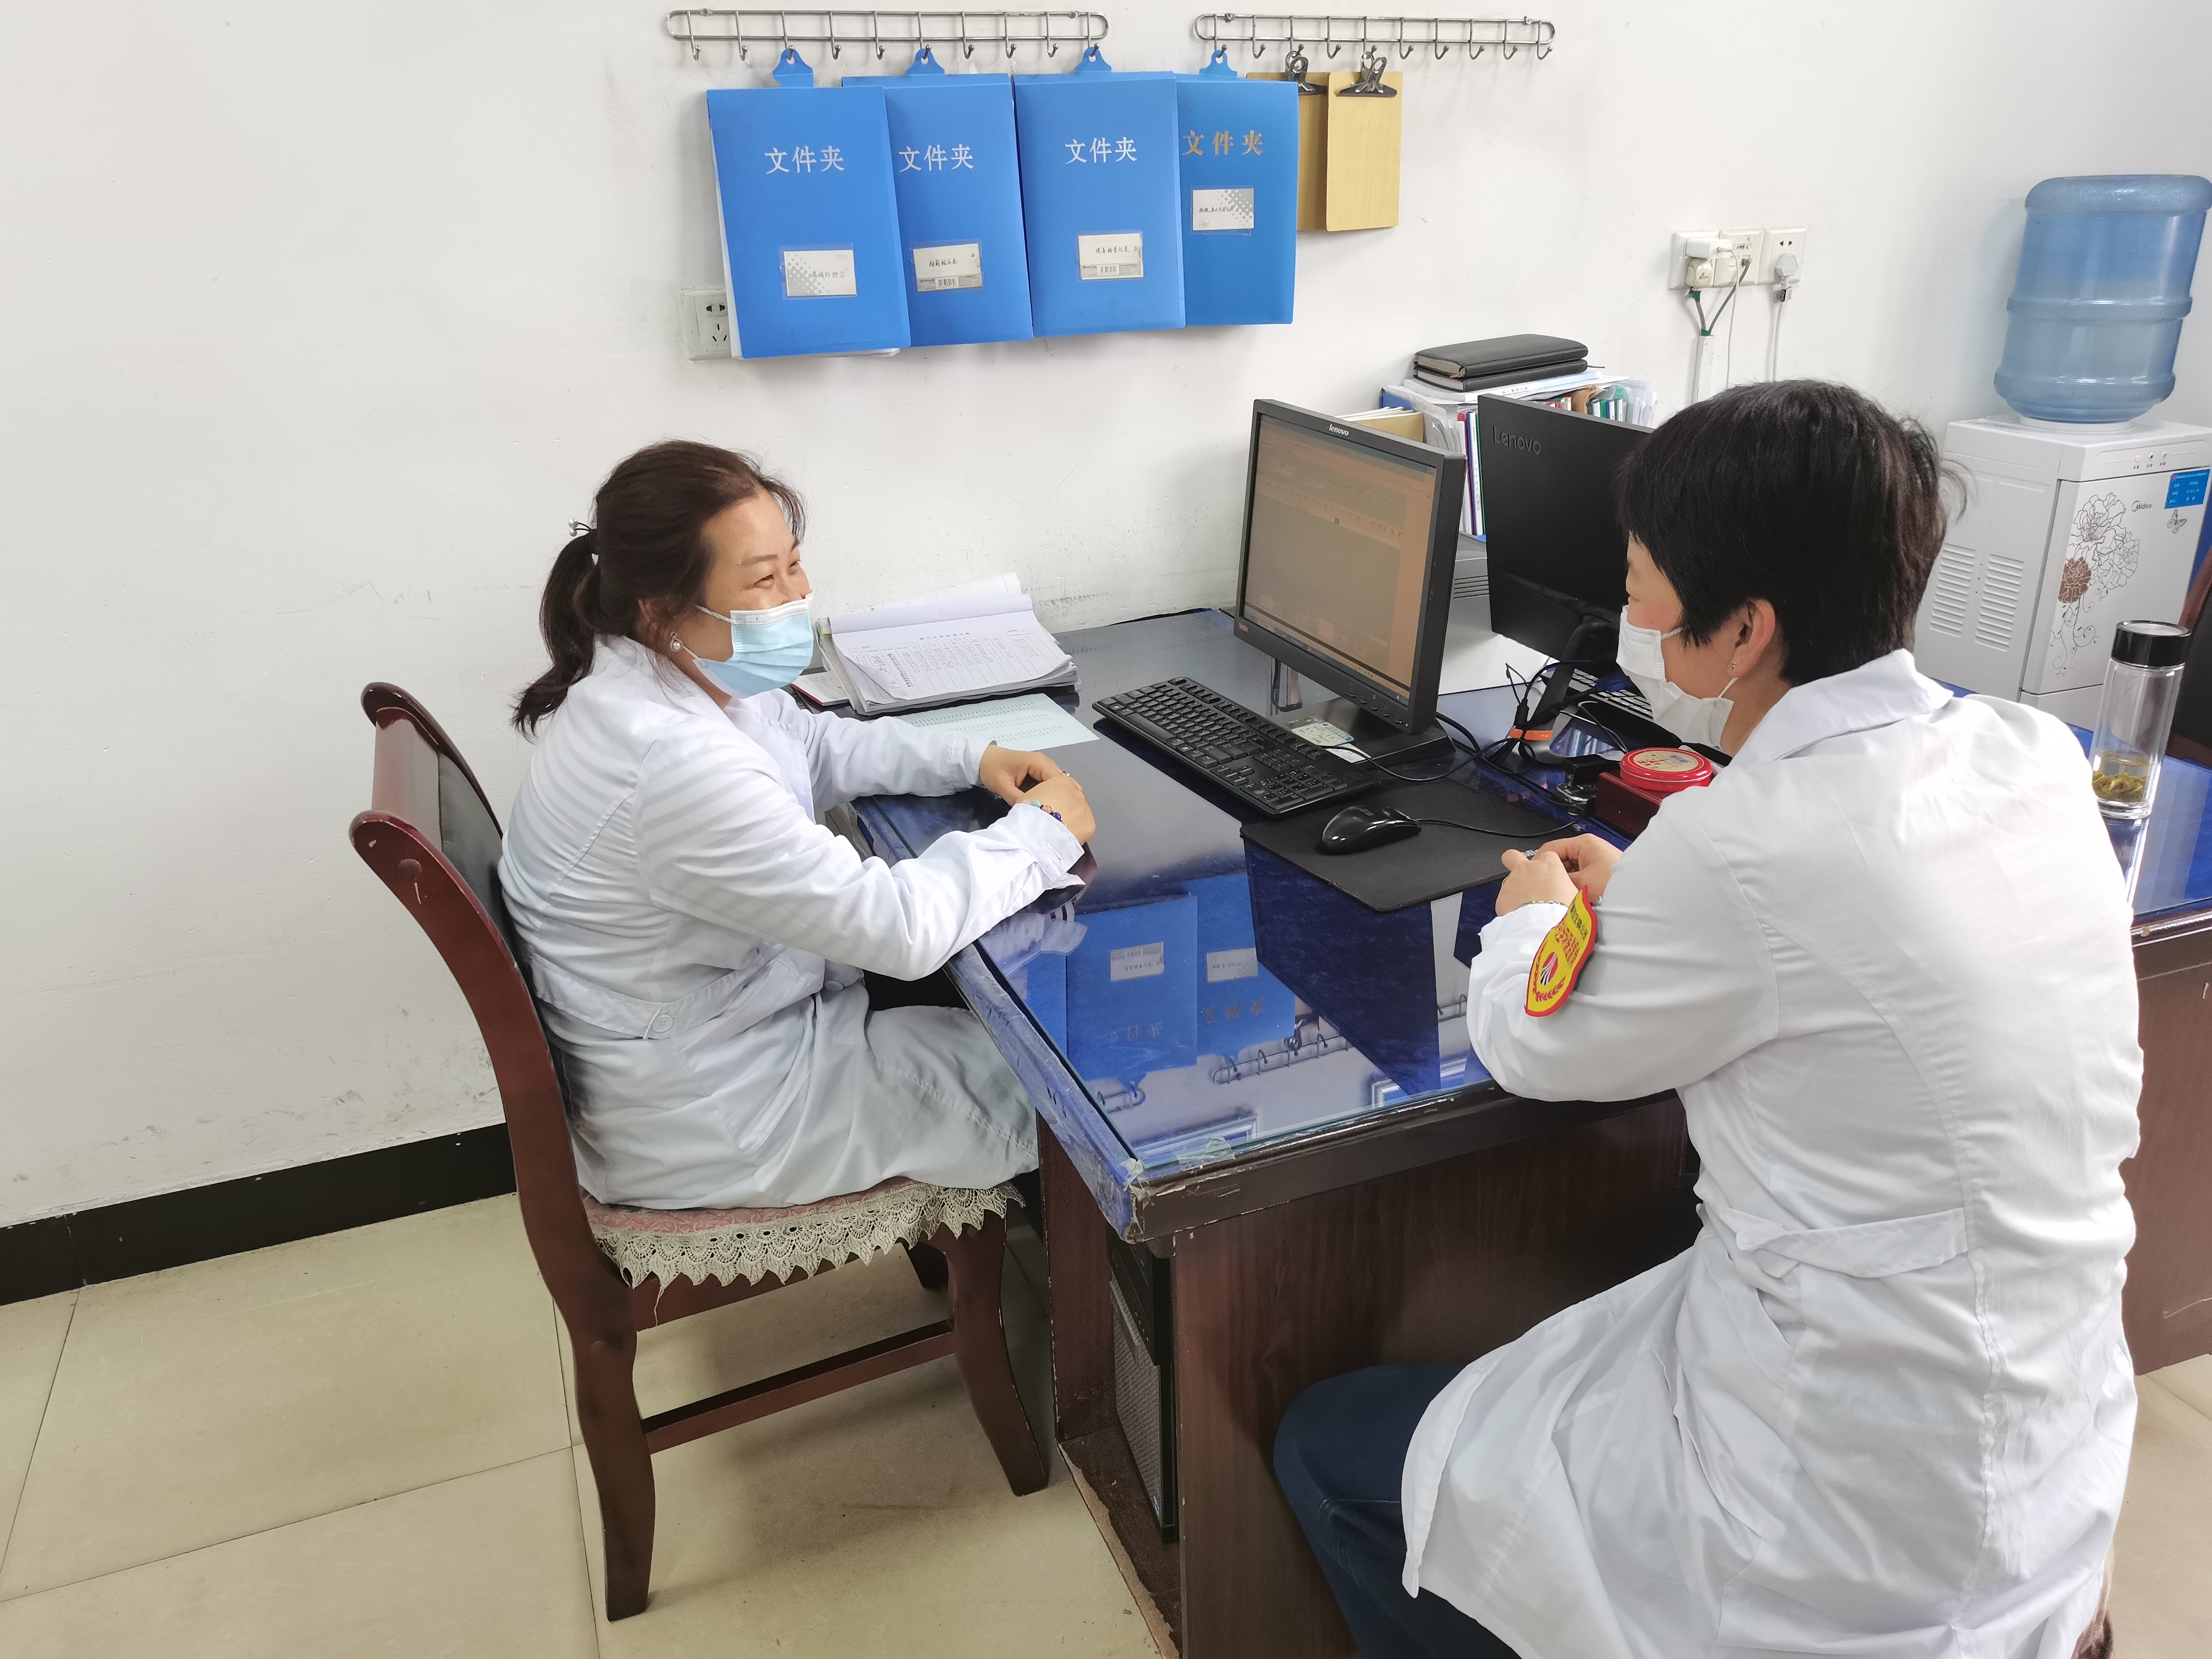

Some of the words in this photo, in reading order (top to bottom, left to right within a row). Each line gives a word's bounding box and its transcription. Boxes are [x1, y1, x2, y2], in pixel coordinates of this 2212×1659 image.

[1065, 137, 1138, 164] 文件夹
[1182, 130, 1263, 156] 文件夹
[764, 145, 845, 174] 文件夹
[898, 144, 974, 173] 文件夹
[1329, 423, 1349, 436] lenovo
[1492, 425, 1540, 455] Lenovo
[2131, 500, 2152, 512] Midea
